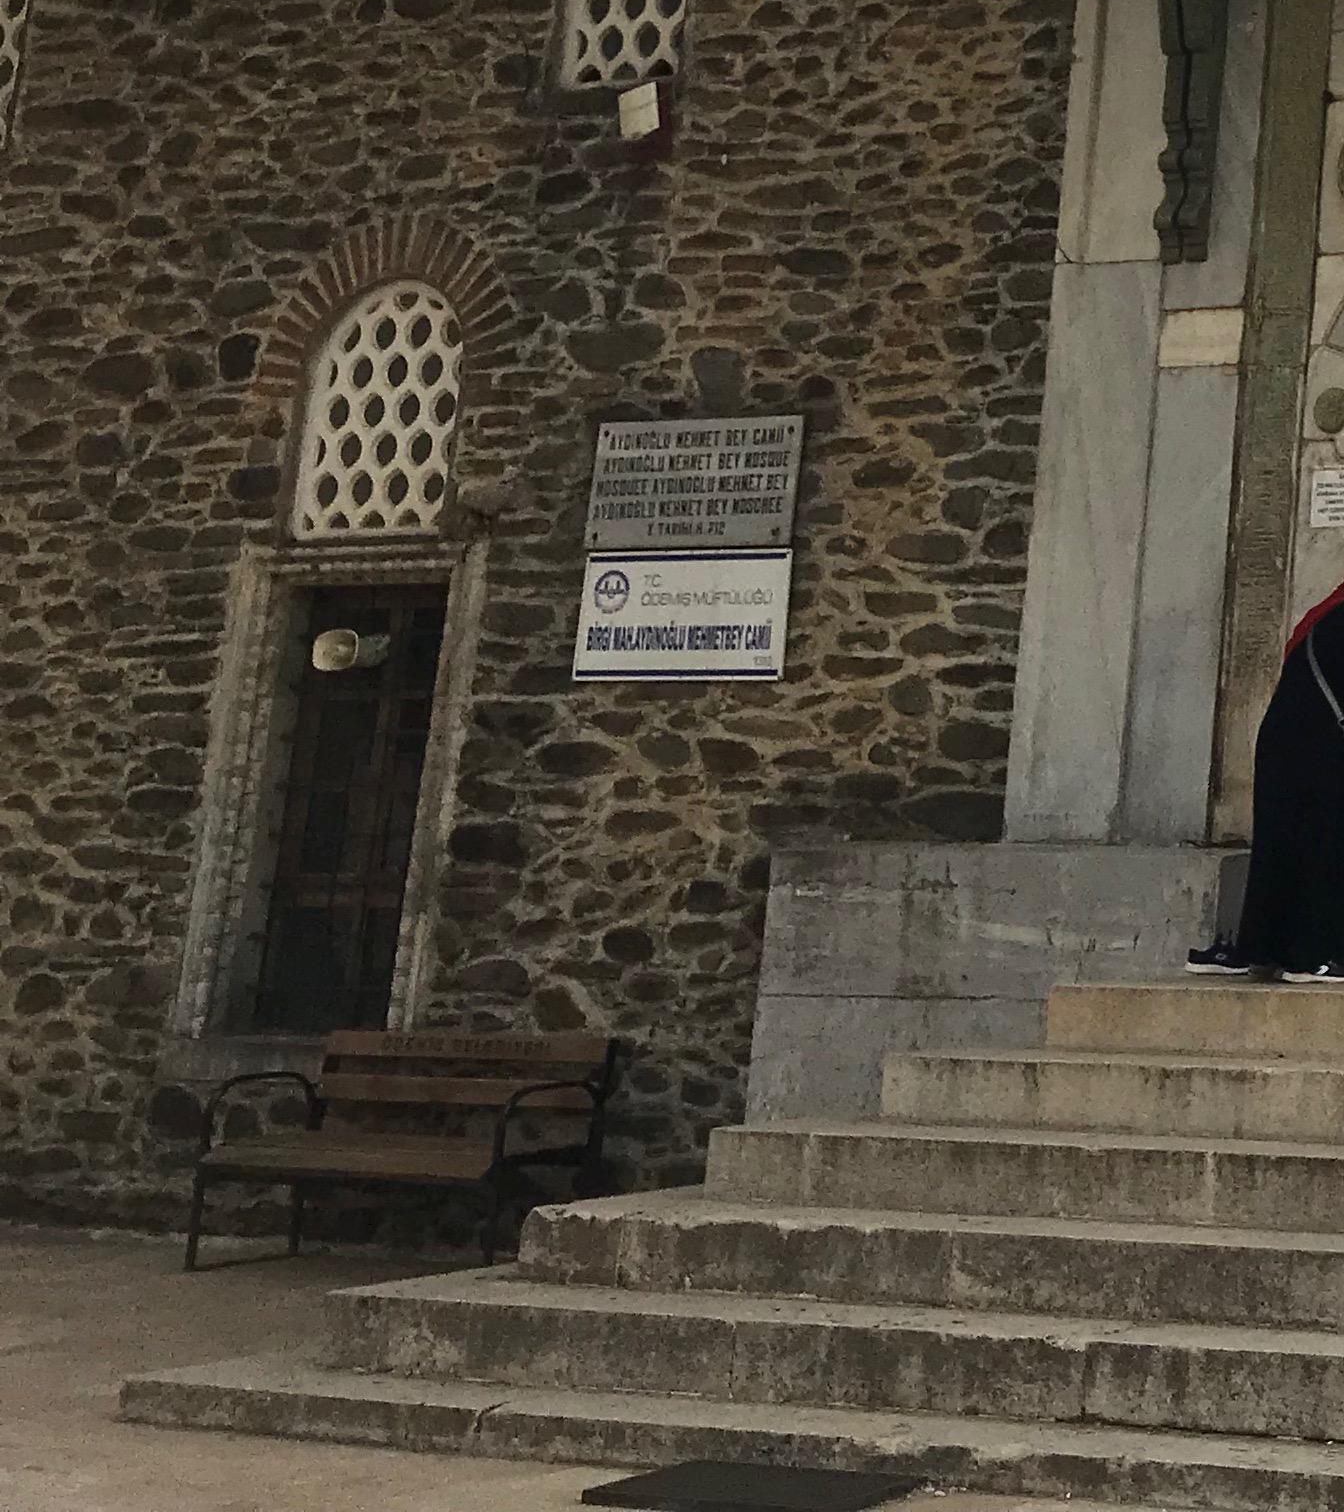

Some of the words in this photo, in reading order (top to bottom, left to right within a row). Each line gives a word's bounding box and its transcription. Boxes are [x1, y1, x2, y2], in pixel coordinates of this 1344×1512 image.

[676, 431, 720, 448] MEHMET
[725, 428, 748, 446] BEY
[668, 452, 712, 472] MEHMET
[718, 451, 741, 470] BEY
[744, 451, 790, 468] MOSQUE
[718, 473, 763, 492] MEHMET
[767, 473, 789, 490] BEY
[659, 499, 703, 517] MEHMET
[706, 498, 729, 516] BEY
[732, 496, 783, 515] MOSCHEE
